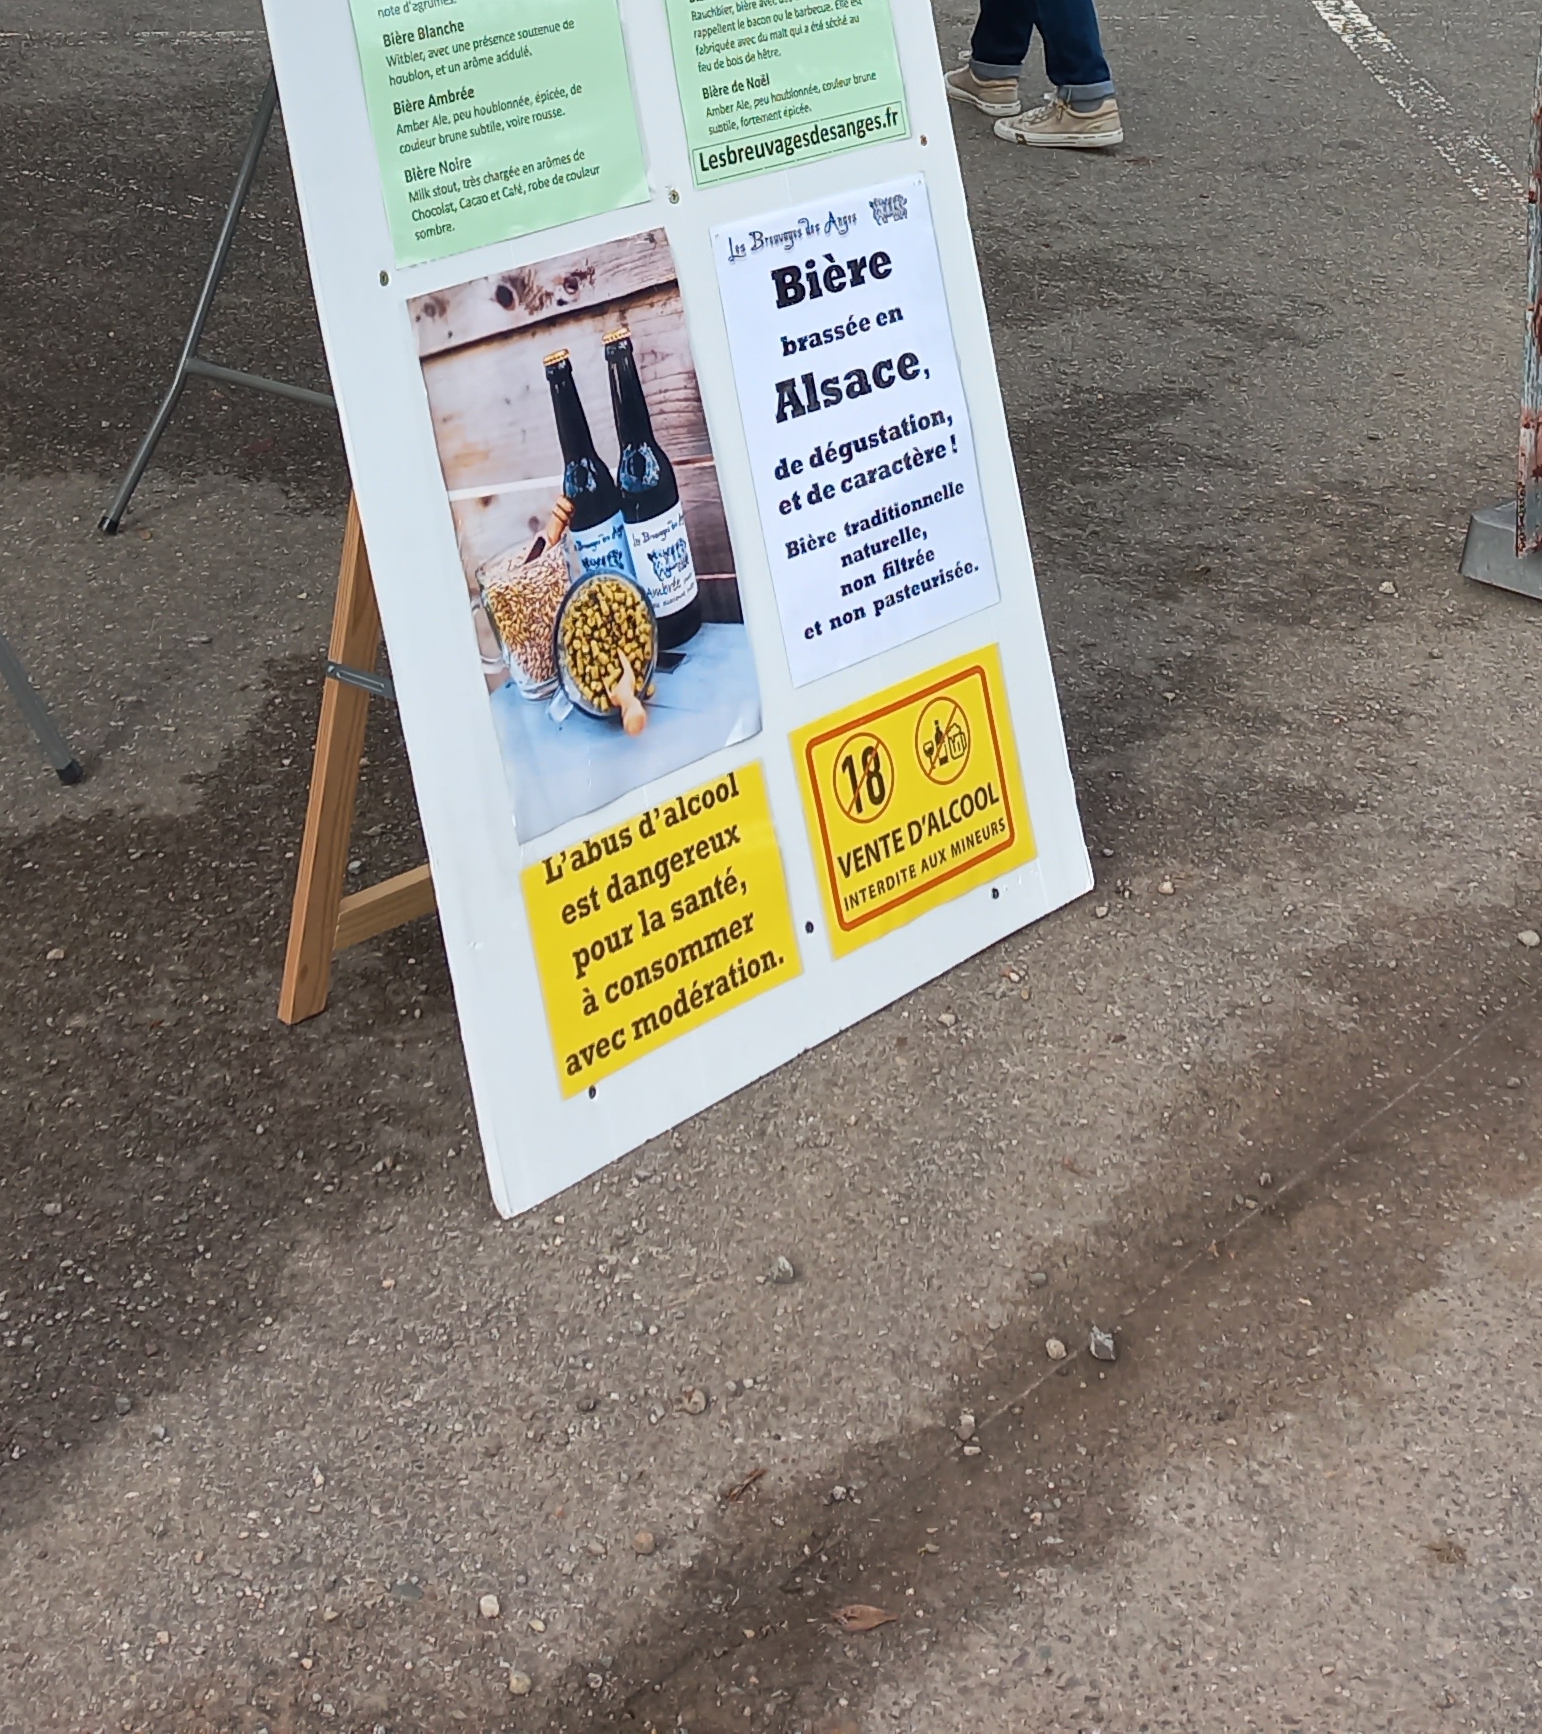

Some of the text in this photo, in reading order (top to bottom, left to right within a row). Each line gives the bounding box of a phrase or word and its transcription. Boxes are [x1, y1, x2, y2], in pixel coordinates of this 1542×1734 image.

[383, 20, 465, 47] Bière Blanche
[393, 86, 475, 116] Bière Ambrée
[404, 155, 472, 184] Bière Noire
[699, 107, 899, 172] Lesbreuvagesdesanges.fr
[770, 249, 893, 309] Bière
[781, 305, 903, 357] brassée en
[774, 350, 931, 424] Alsace,
[774, 407, 954, 480] de dégustation,
[778, 433, 959, 516] et de caractère !
[841, 744, 887, 814] 18
[542, 772, 740, 886] L'abus d'alcool
[837, 782, 1000, 880] VENTE D'ALCOOL
[843, 816, 1007, 913] INTERDITE AUX MINEURS
[561, 825, 742, 926] est dangereux
[572, 867, 748, 980] pour la santé,
[582, 911, 756, 1018] à consommer
[564, 947, 785, 1077] avec modération.
